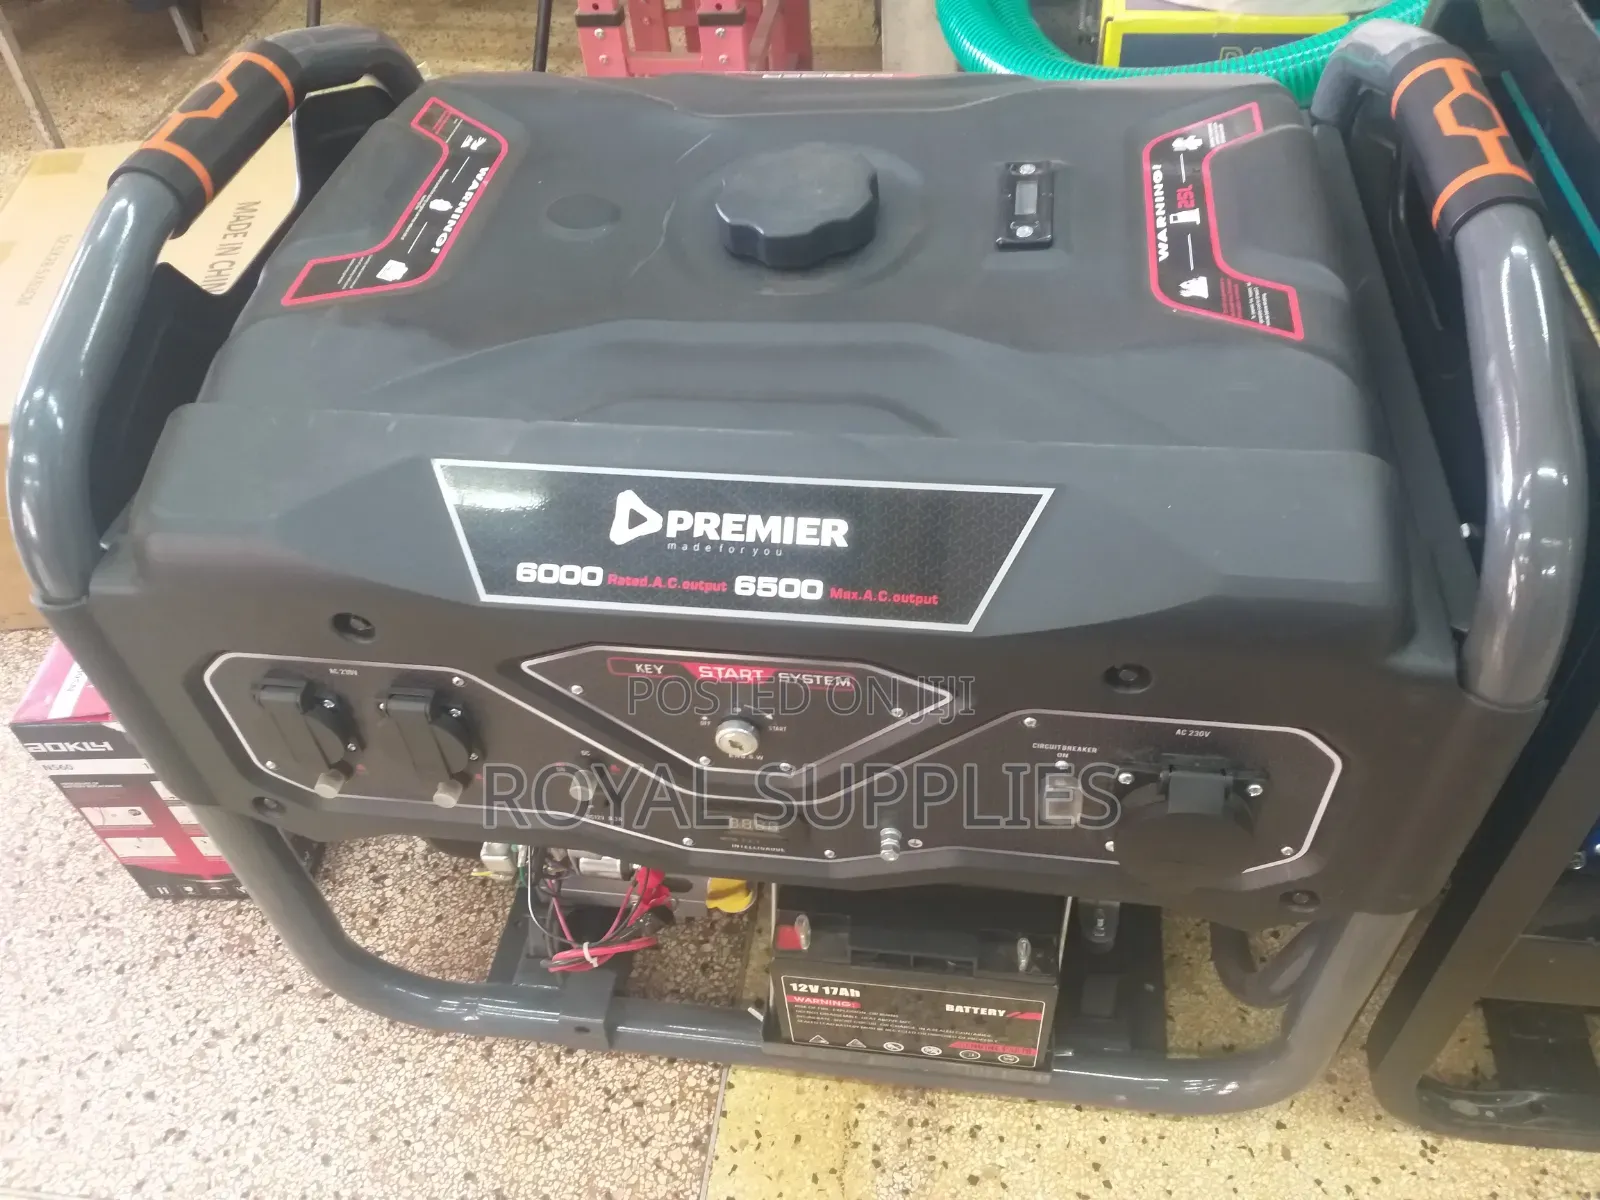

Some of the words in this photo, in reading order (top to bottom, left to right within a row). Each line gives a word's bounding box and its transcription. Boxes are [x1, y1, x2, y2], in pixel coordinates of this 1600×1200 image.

[1176, 184, 1196, 209] 25L
[222, 200, 261, 240] MADE
[431, 166, 490, 254] WARNING!
[1152, 164, 1170, 262] WARNING!
[214, 241, 244, 256] IN
[666, 510, 849, 547] PREMIER
[667, 541, 712, 553] made
[719, 544, 745, 554] for
[752, 547, 783, 558] you
[515, 562, 604, 587] 6000
[734, 575, 824, 600] 6500
[635, 663, 664, 675] KEY
[698, 665, 764, 681] START
[778, 671, 851, 688] SYSTEM
[1188, 729, 1211, 738] 230V
[789, 983, 819, 994] 12V
[821, 986, 861, 998] 17Ah
[794, 995, 856, 1007] WARNING:
[945, 1003, 1007, 1017] BATTERY
